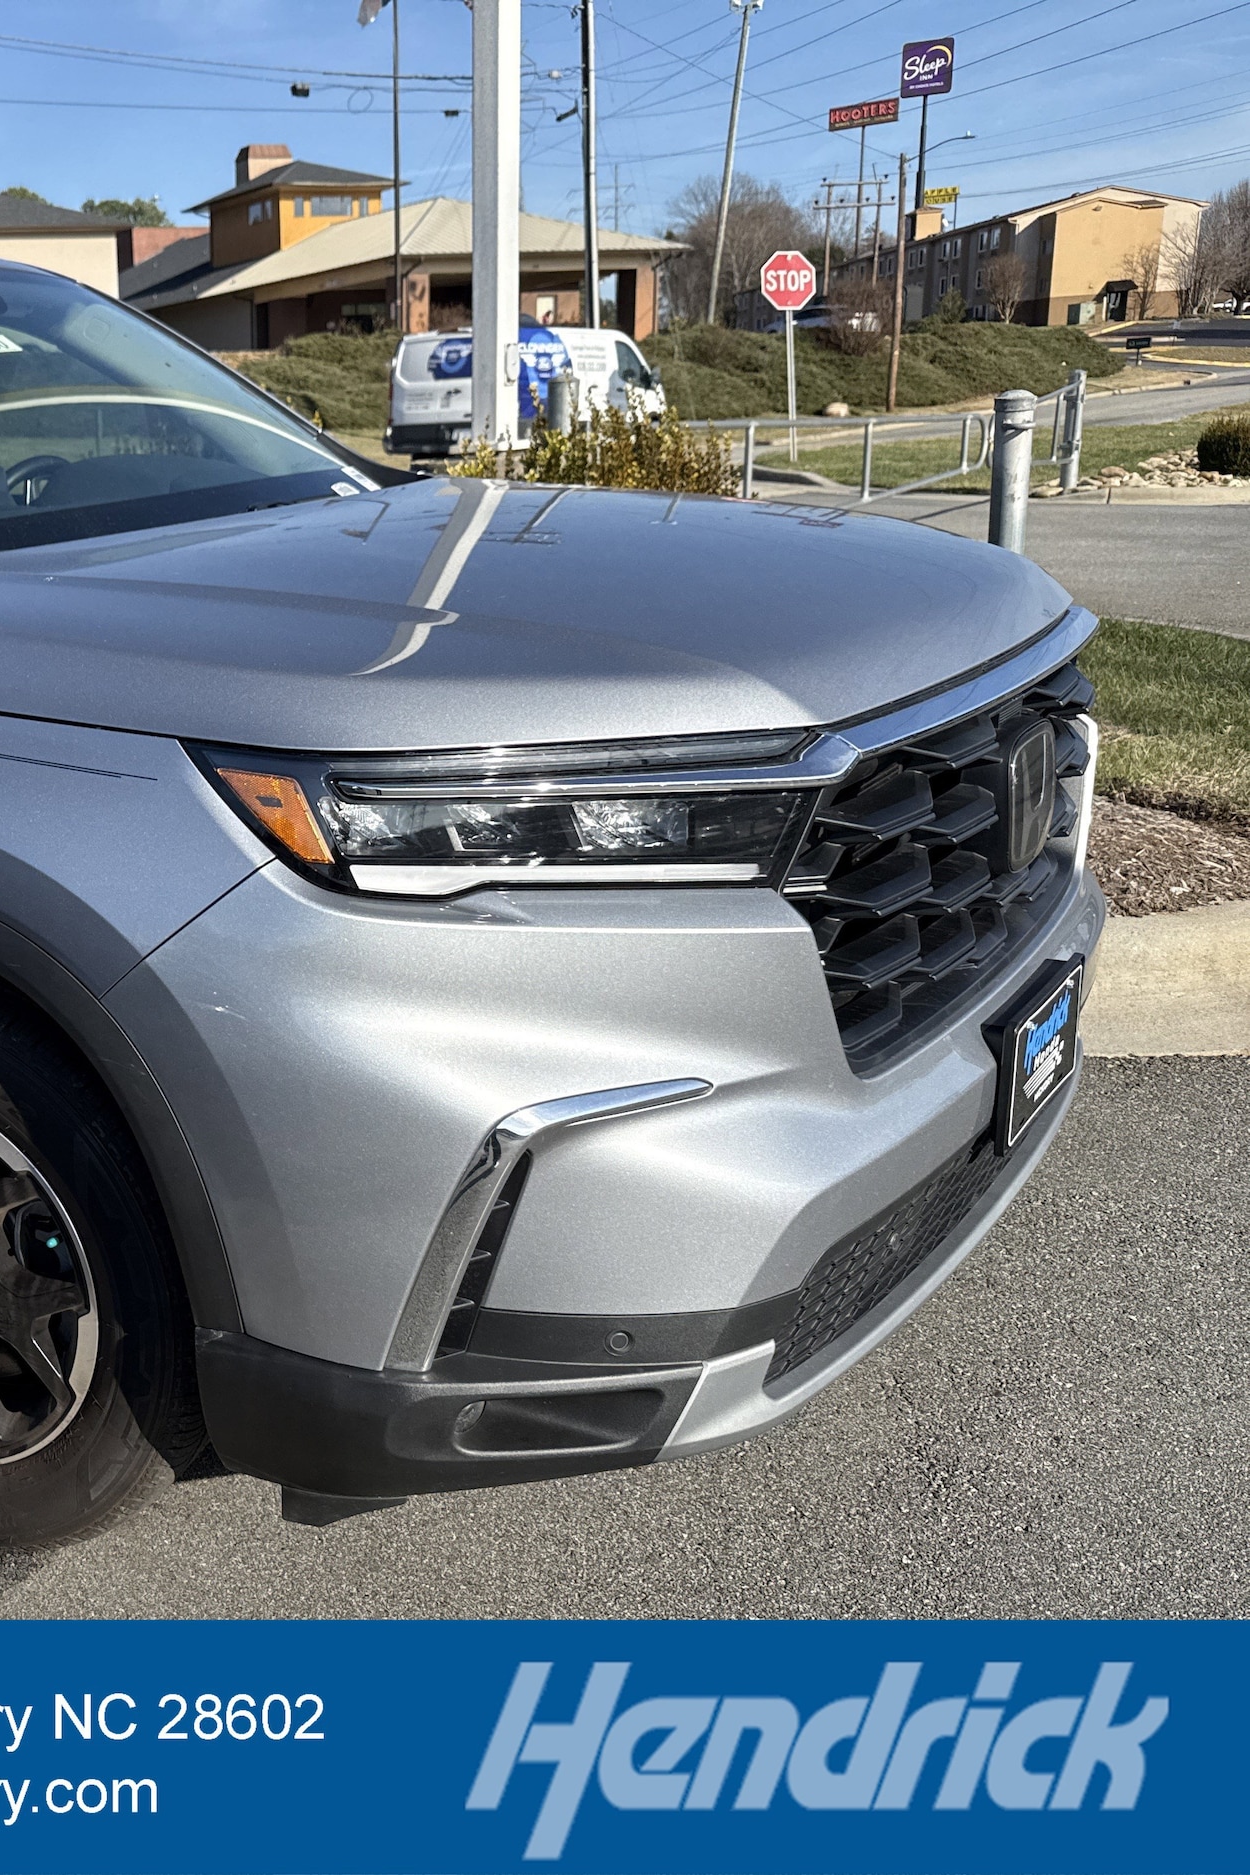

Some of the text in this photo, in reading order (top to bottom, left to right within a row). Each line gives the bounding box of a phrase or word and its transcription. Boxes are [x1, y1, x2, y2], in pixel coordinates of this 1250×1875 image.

[903, 54, 947, 81] Sleep
[830, 101, 896, 123] HOOTERS
[765, 269, 812, 292] STOP
[1023, 988, 1071, 1076] Hendrick
[1033, 1034, 1061, 1072] Honda
